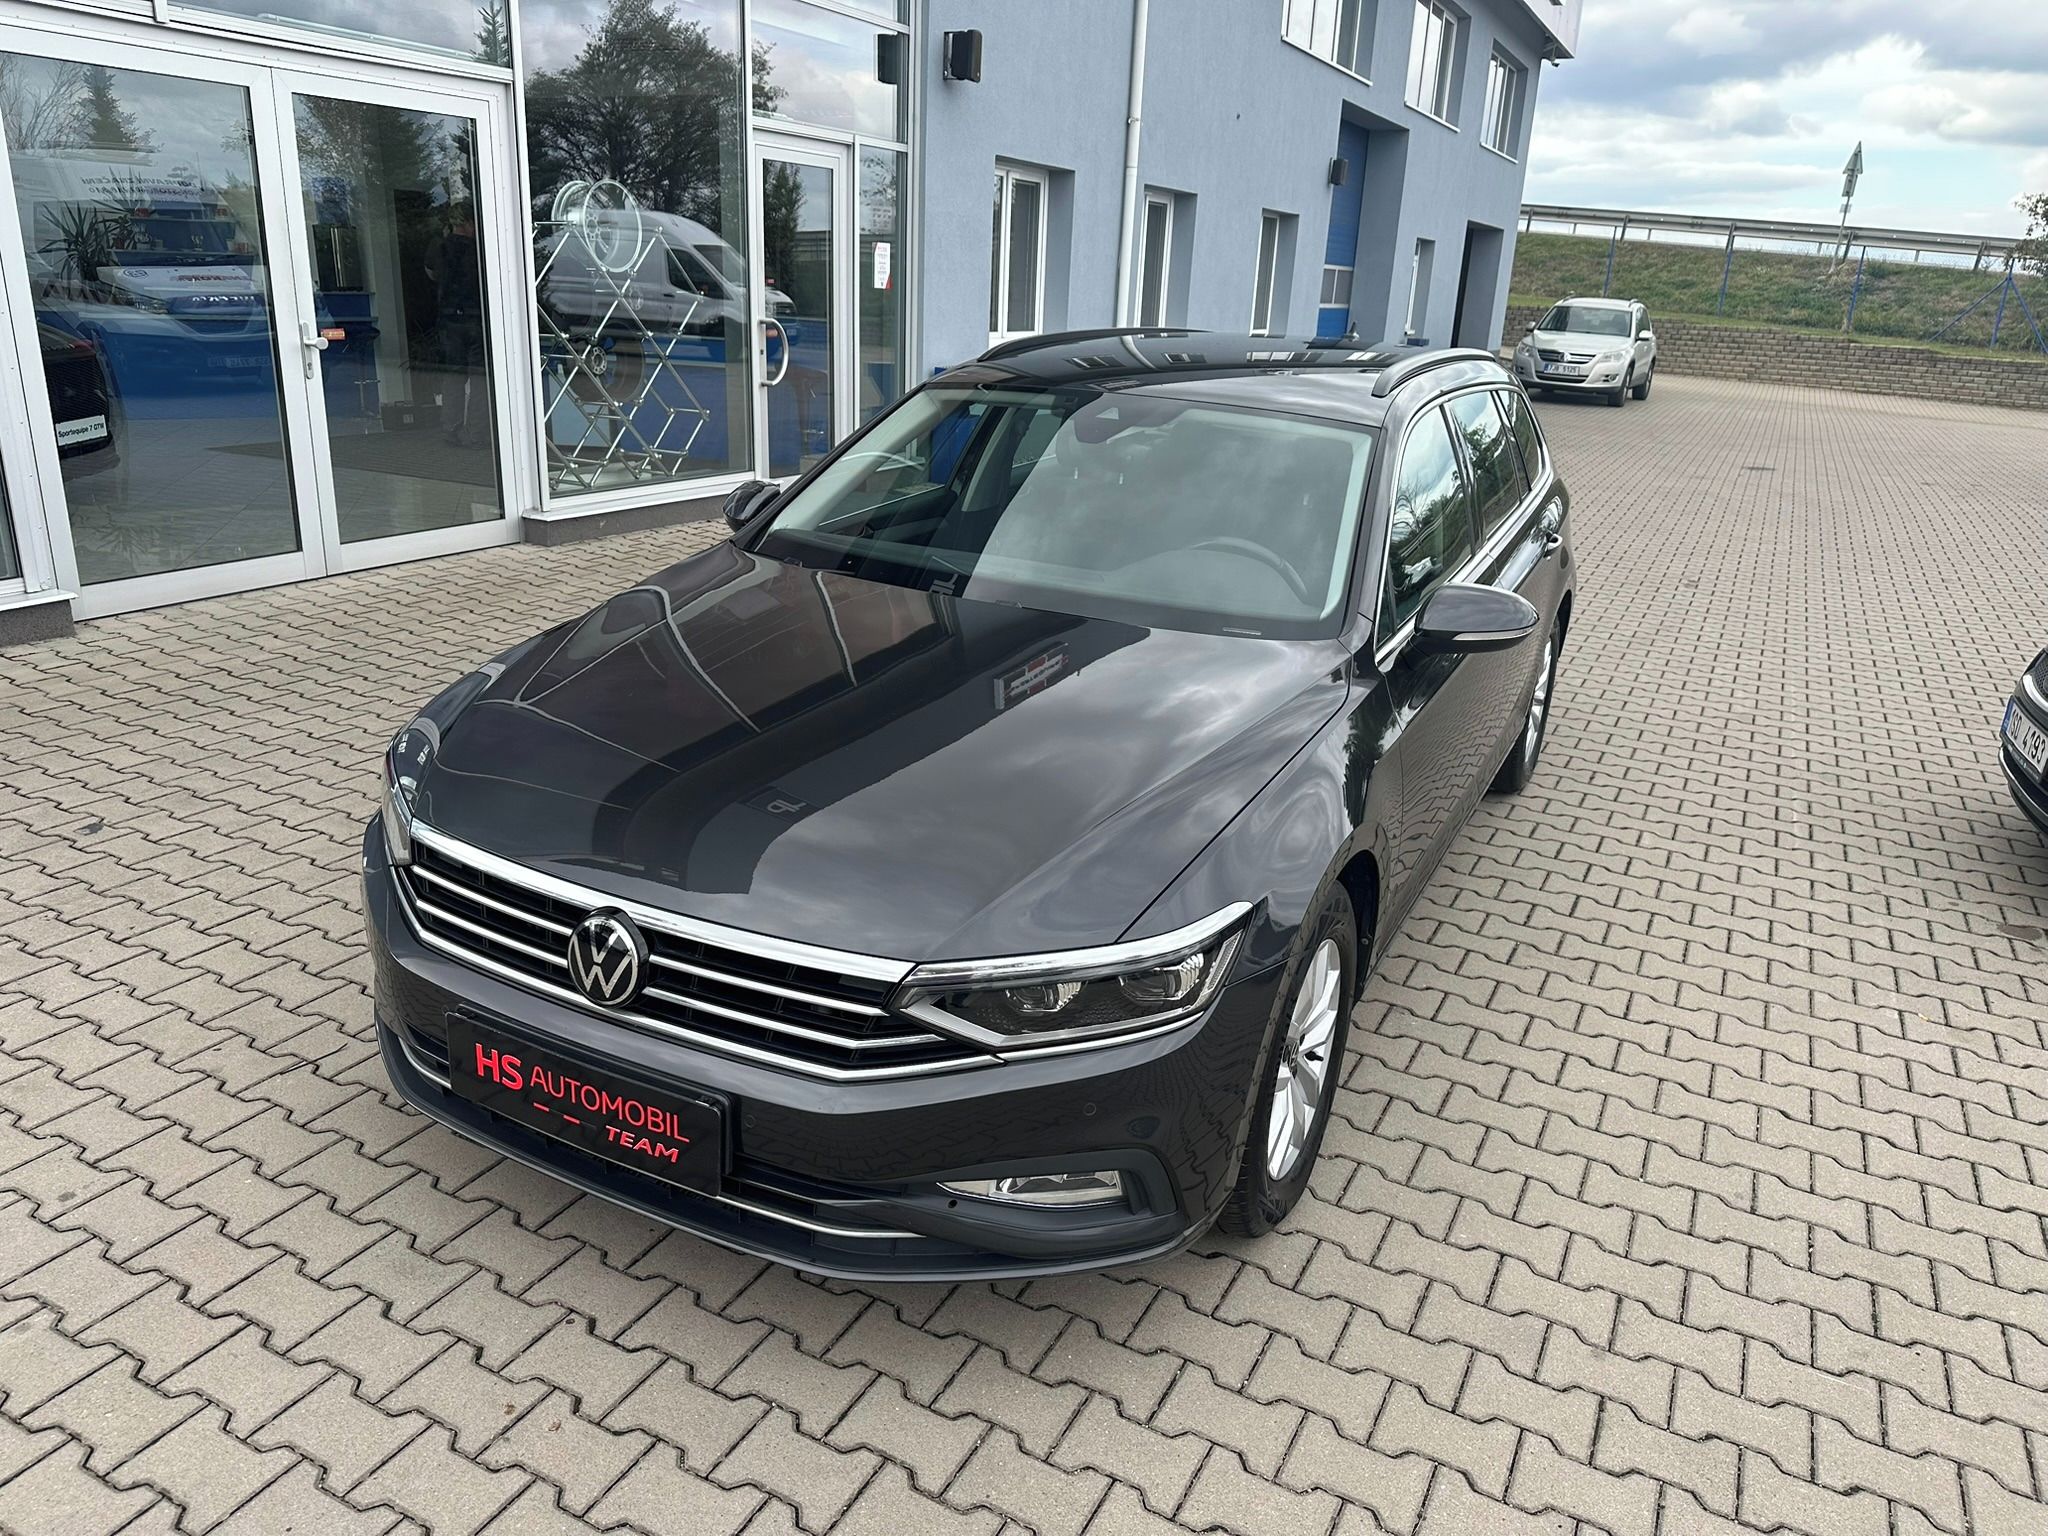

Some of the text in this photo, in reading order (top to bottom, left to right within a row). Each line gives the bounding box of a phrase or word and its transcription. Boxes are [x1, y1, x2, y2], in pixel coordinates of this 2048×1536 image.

[2022, 726, 2046, 765] 4193
[475, 1042, 690, 1143] HS AUTOMOBIL
[605, 1124, 680, 1164] TEAM
